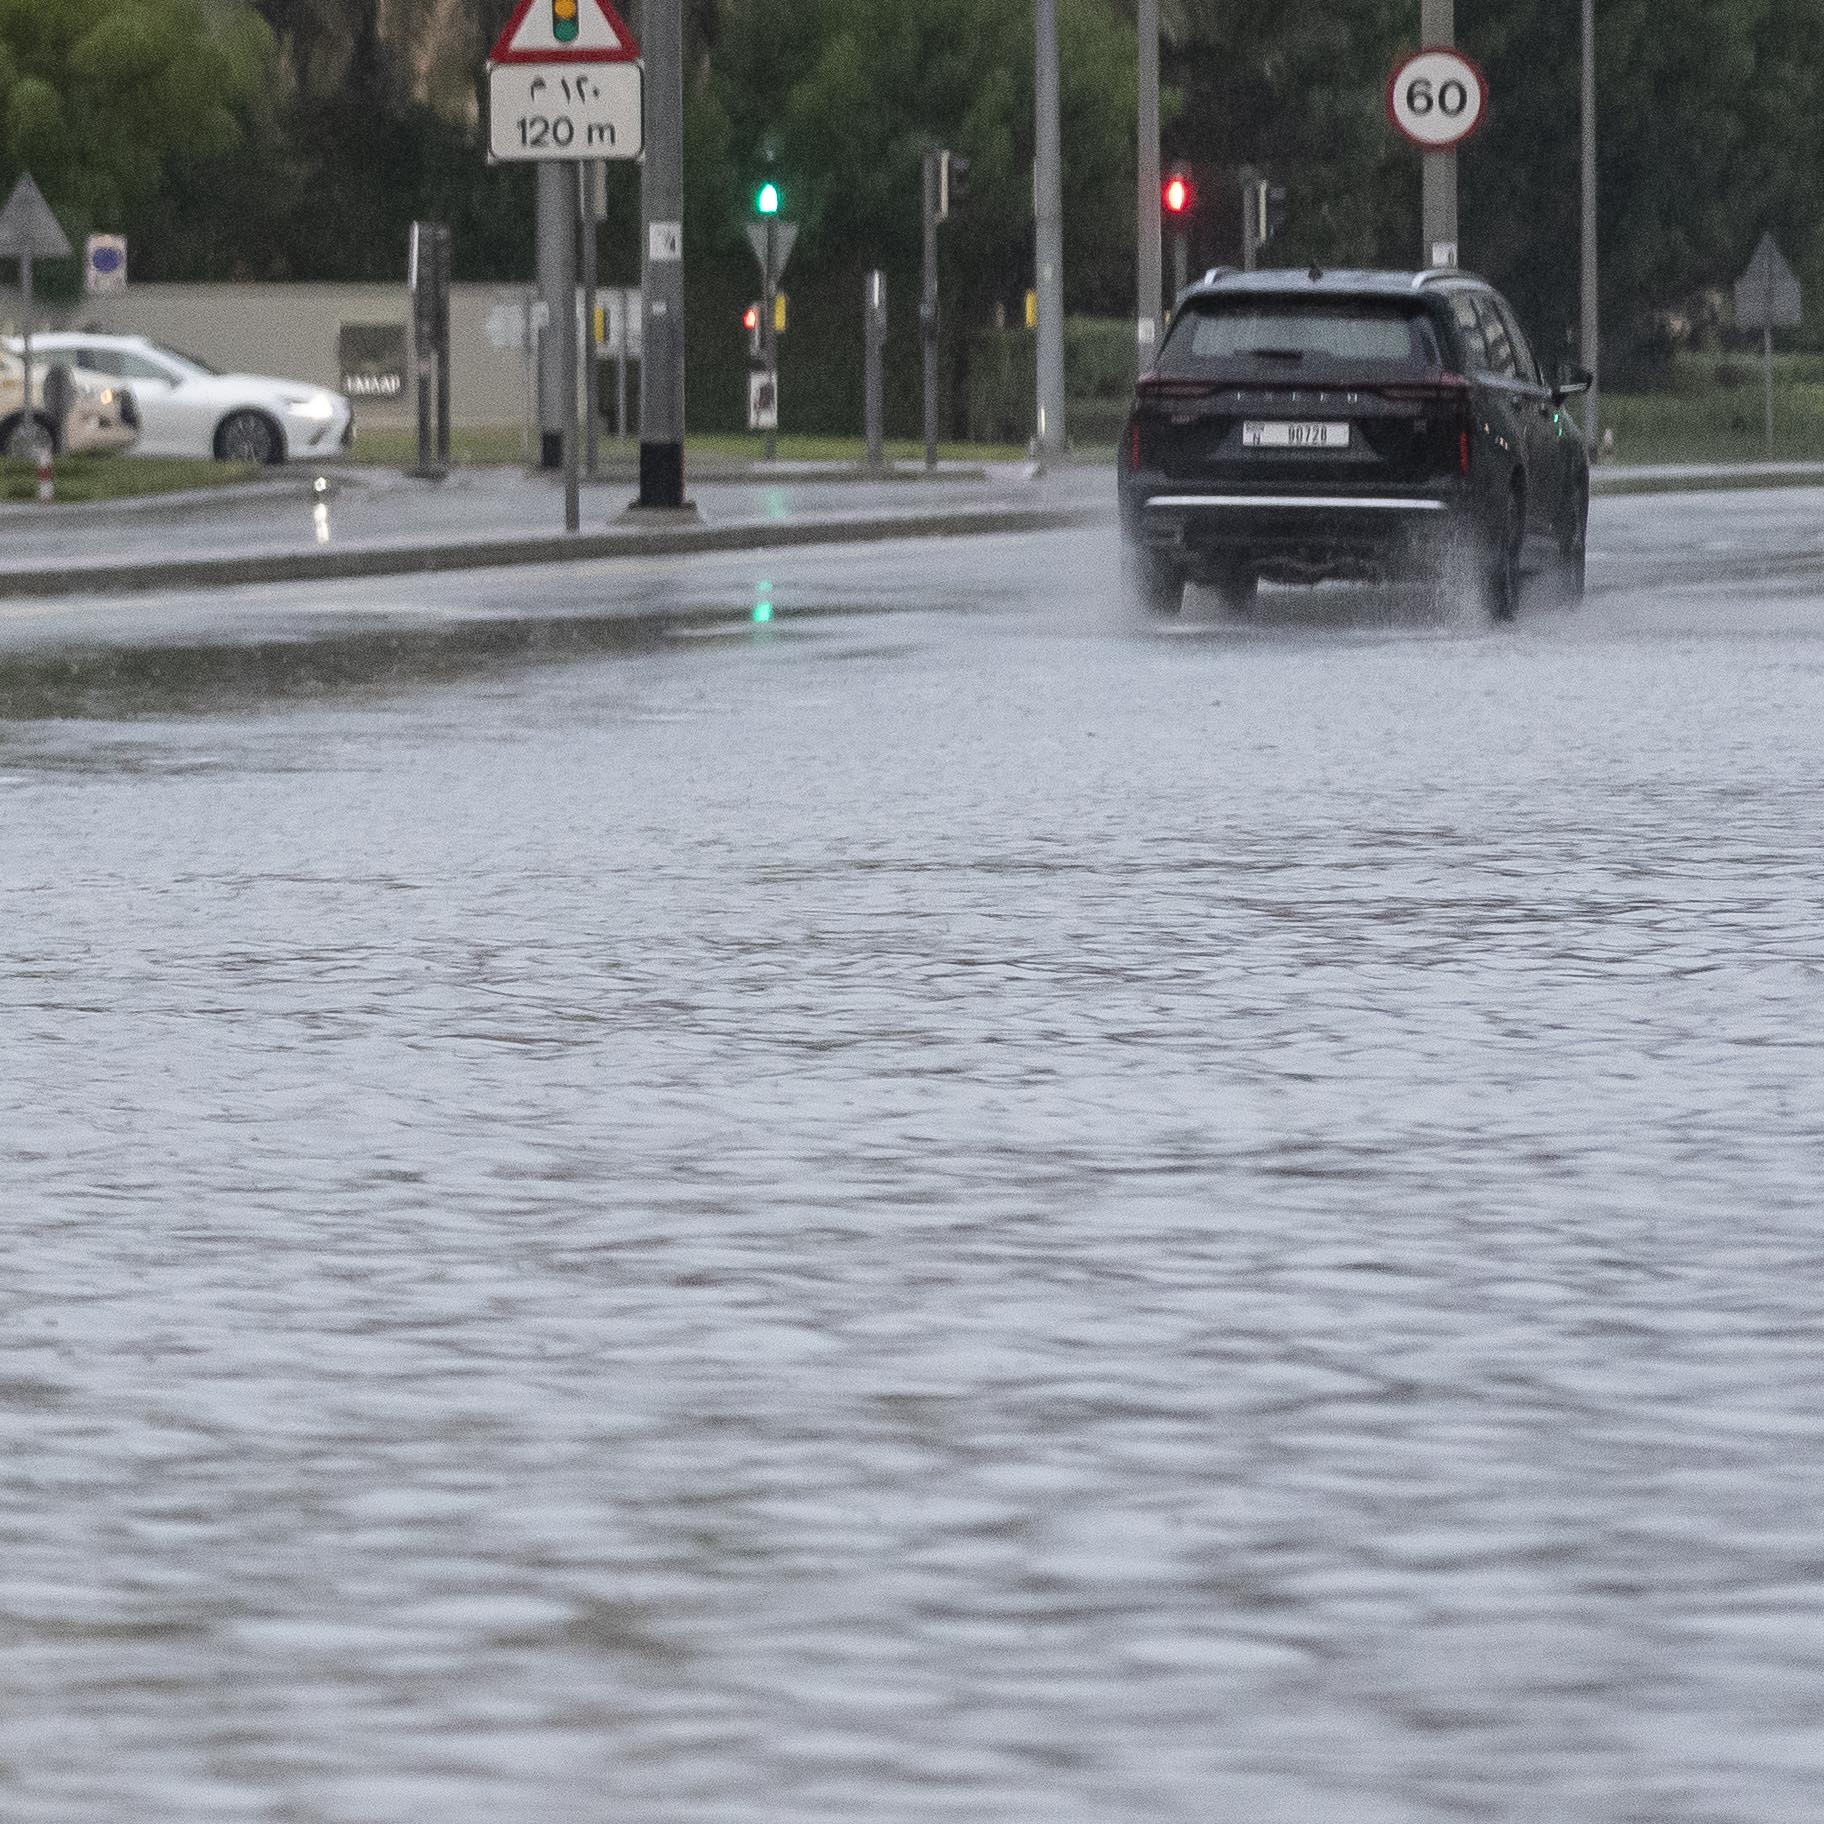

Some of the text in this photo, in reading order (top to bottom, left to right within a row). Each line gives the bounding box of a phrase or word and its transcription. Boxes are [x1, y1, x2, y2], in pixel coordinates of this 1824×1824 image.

[1404, 78, 1469, 117] 60
[515, 116, 617, 148] 120 m
